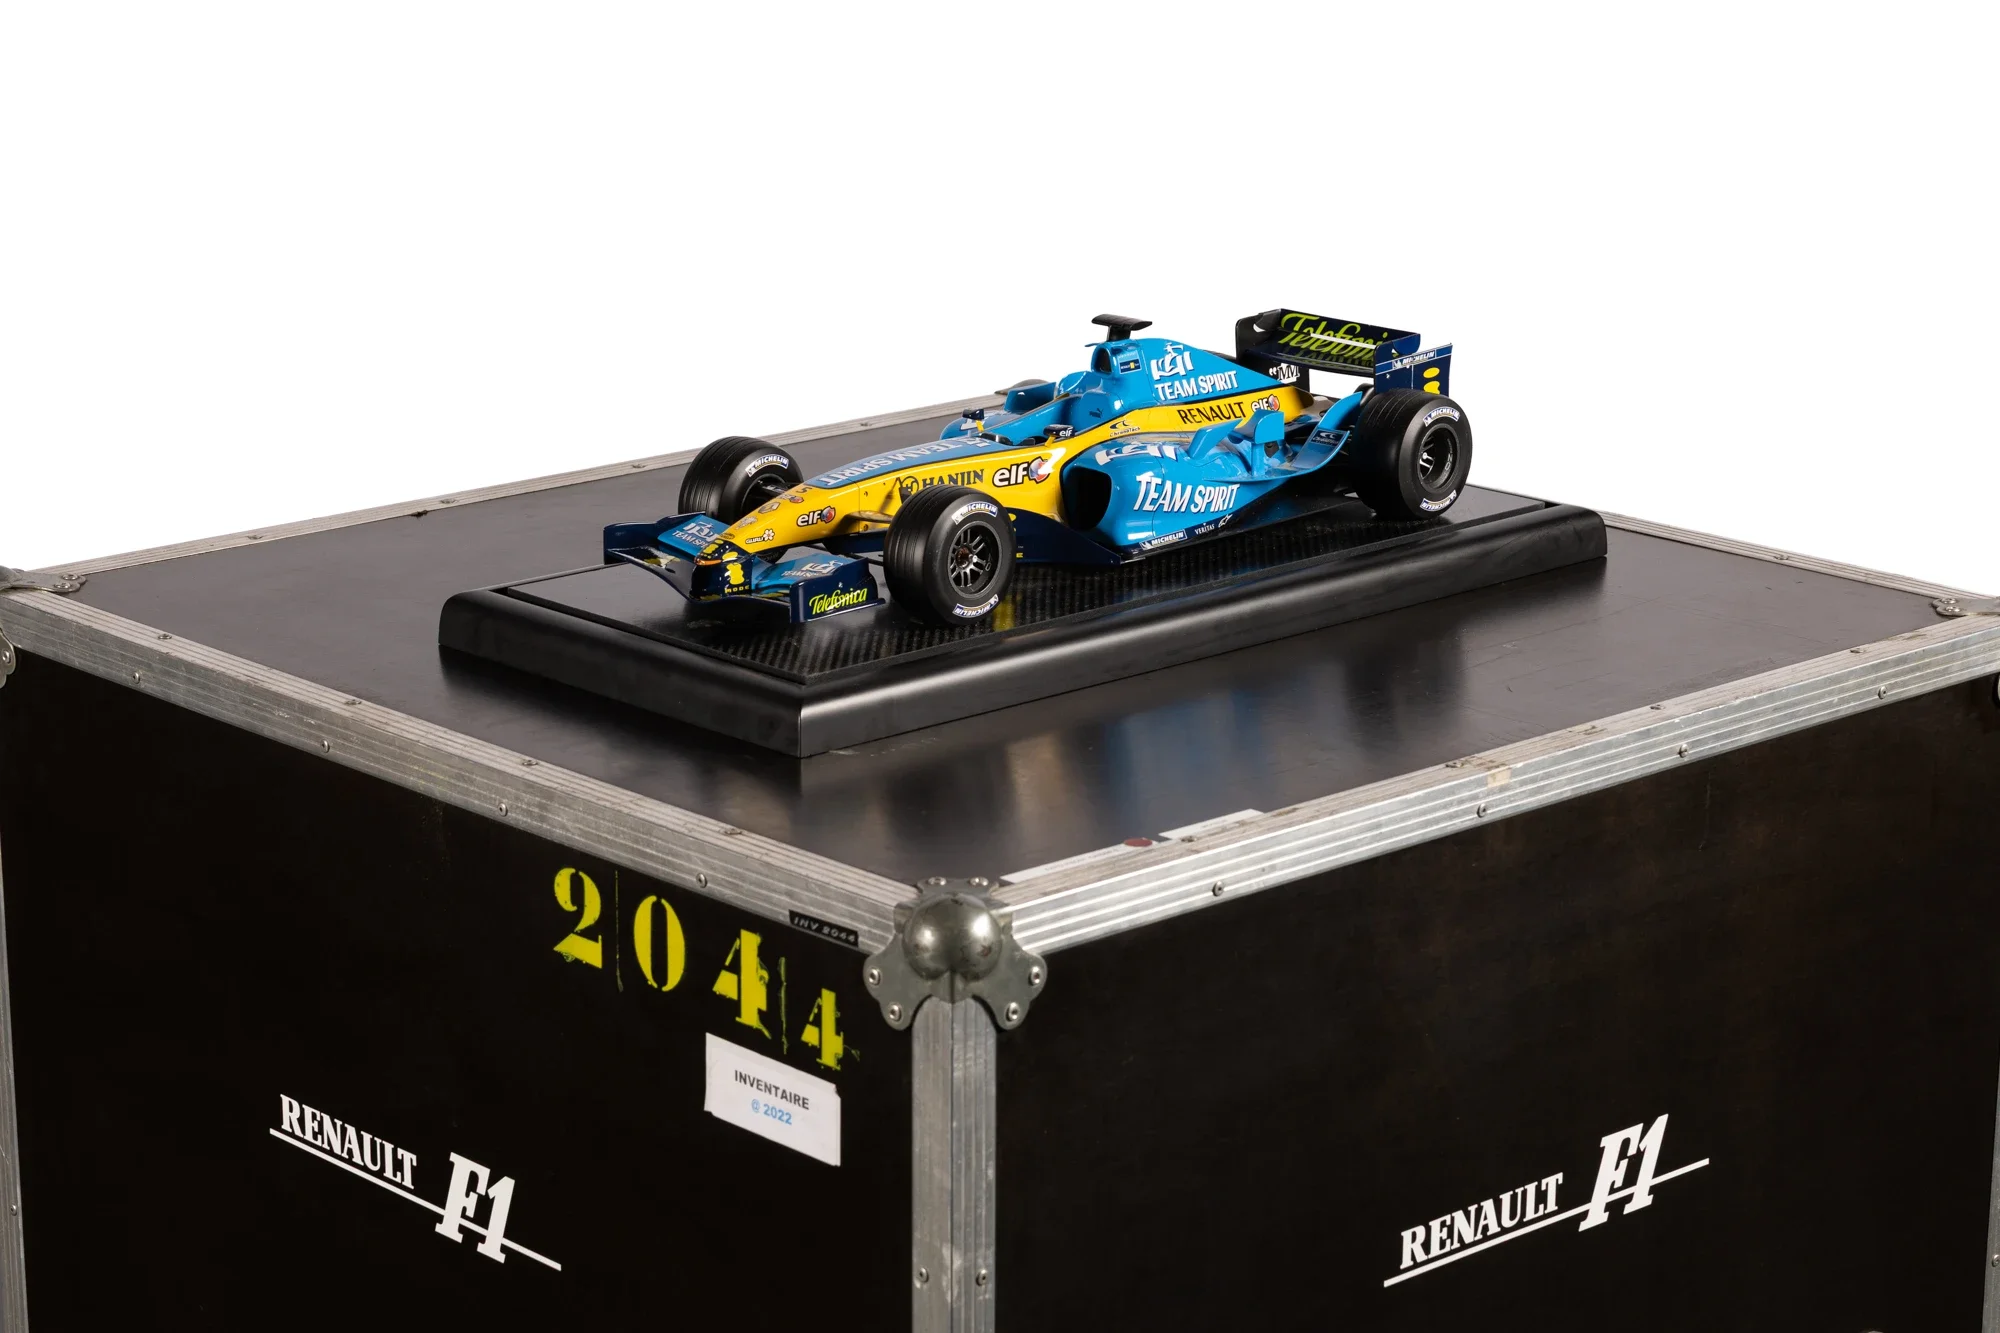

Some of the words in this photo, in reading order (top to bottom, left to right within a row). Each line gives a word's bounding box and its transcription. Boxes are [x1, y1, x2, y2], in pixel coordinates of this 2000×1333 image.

[1154, 379, 1198, 401] TEAM
[1199, 370, 1239, 394] SPIRIT
[1177, 401, 1247, 425] RENAULT
[1059, 427, 1073, 438] elf
[889, 440, 963, 462] TEAM
[818, 459, 894, 486] SPIRIT
[921, 468, 985, 489] HANJIN
[992, 462, 1031, 488] elf
[1133, 472, 1192, 513] TEAM
[1190, 483, 1240, 514] SPIRIT
[797, 510, 822, 527] elf
[1195, 523, 1215, 535] VERITAS
[1151, 532, 1184, 546] MICHELIN
[794, 916, 819, 931] INV
[821, 926, 856, 943] 2044
[734, 1069, 810, 1111] INVENTAIRE
[763, 1103, 793, 1126] 2022
[280, 1093, 417, 1190] RENAULT
[434, 1151, 516, 1264] F1
[1400, 1171, 1564, 1270] RENAULT
[1578, 1113, 1669, 1232] F1
